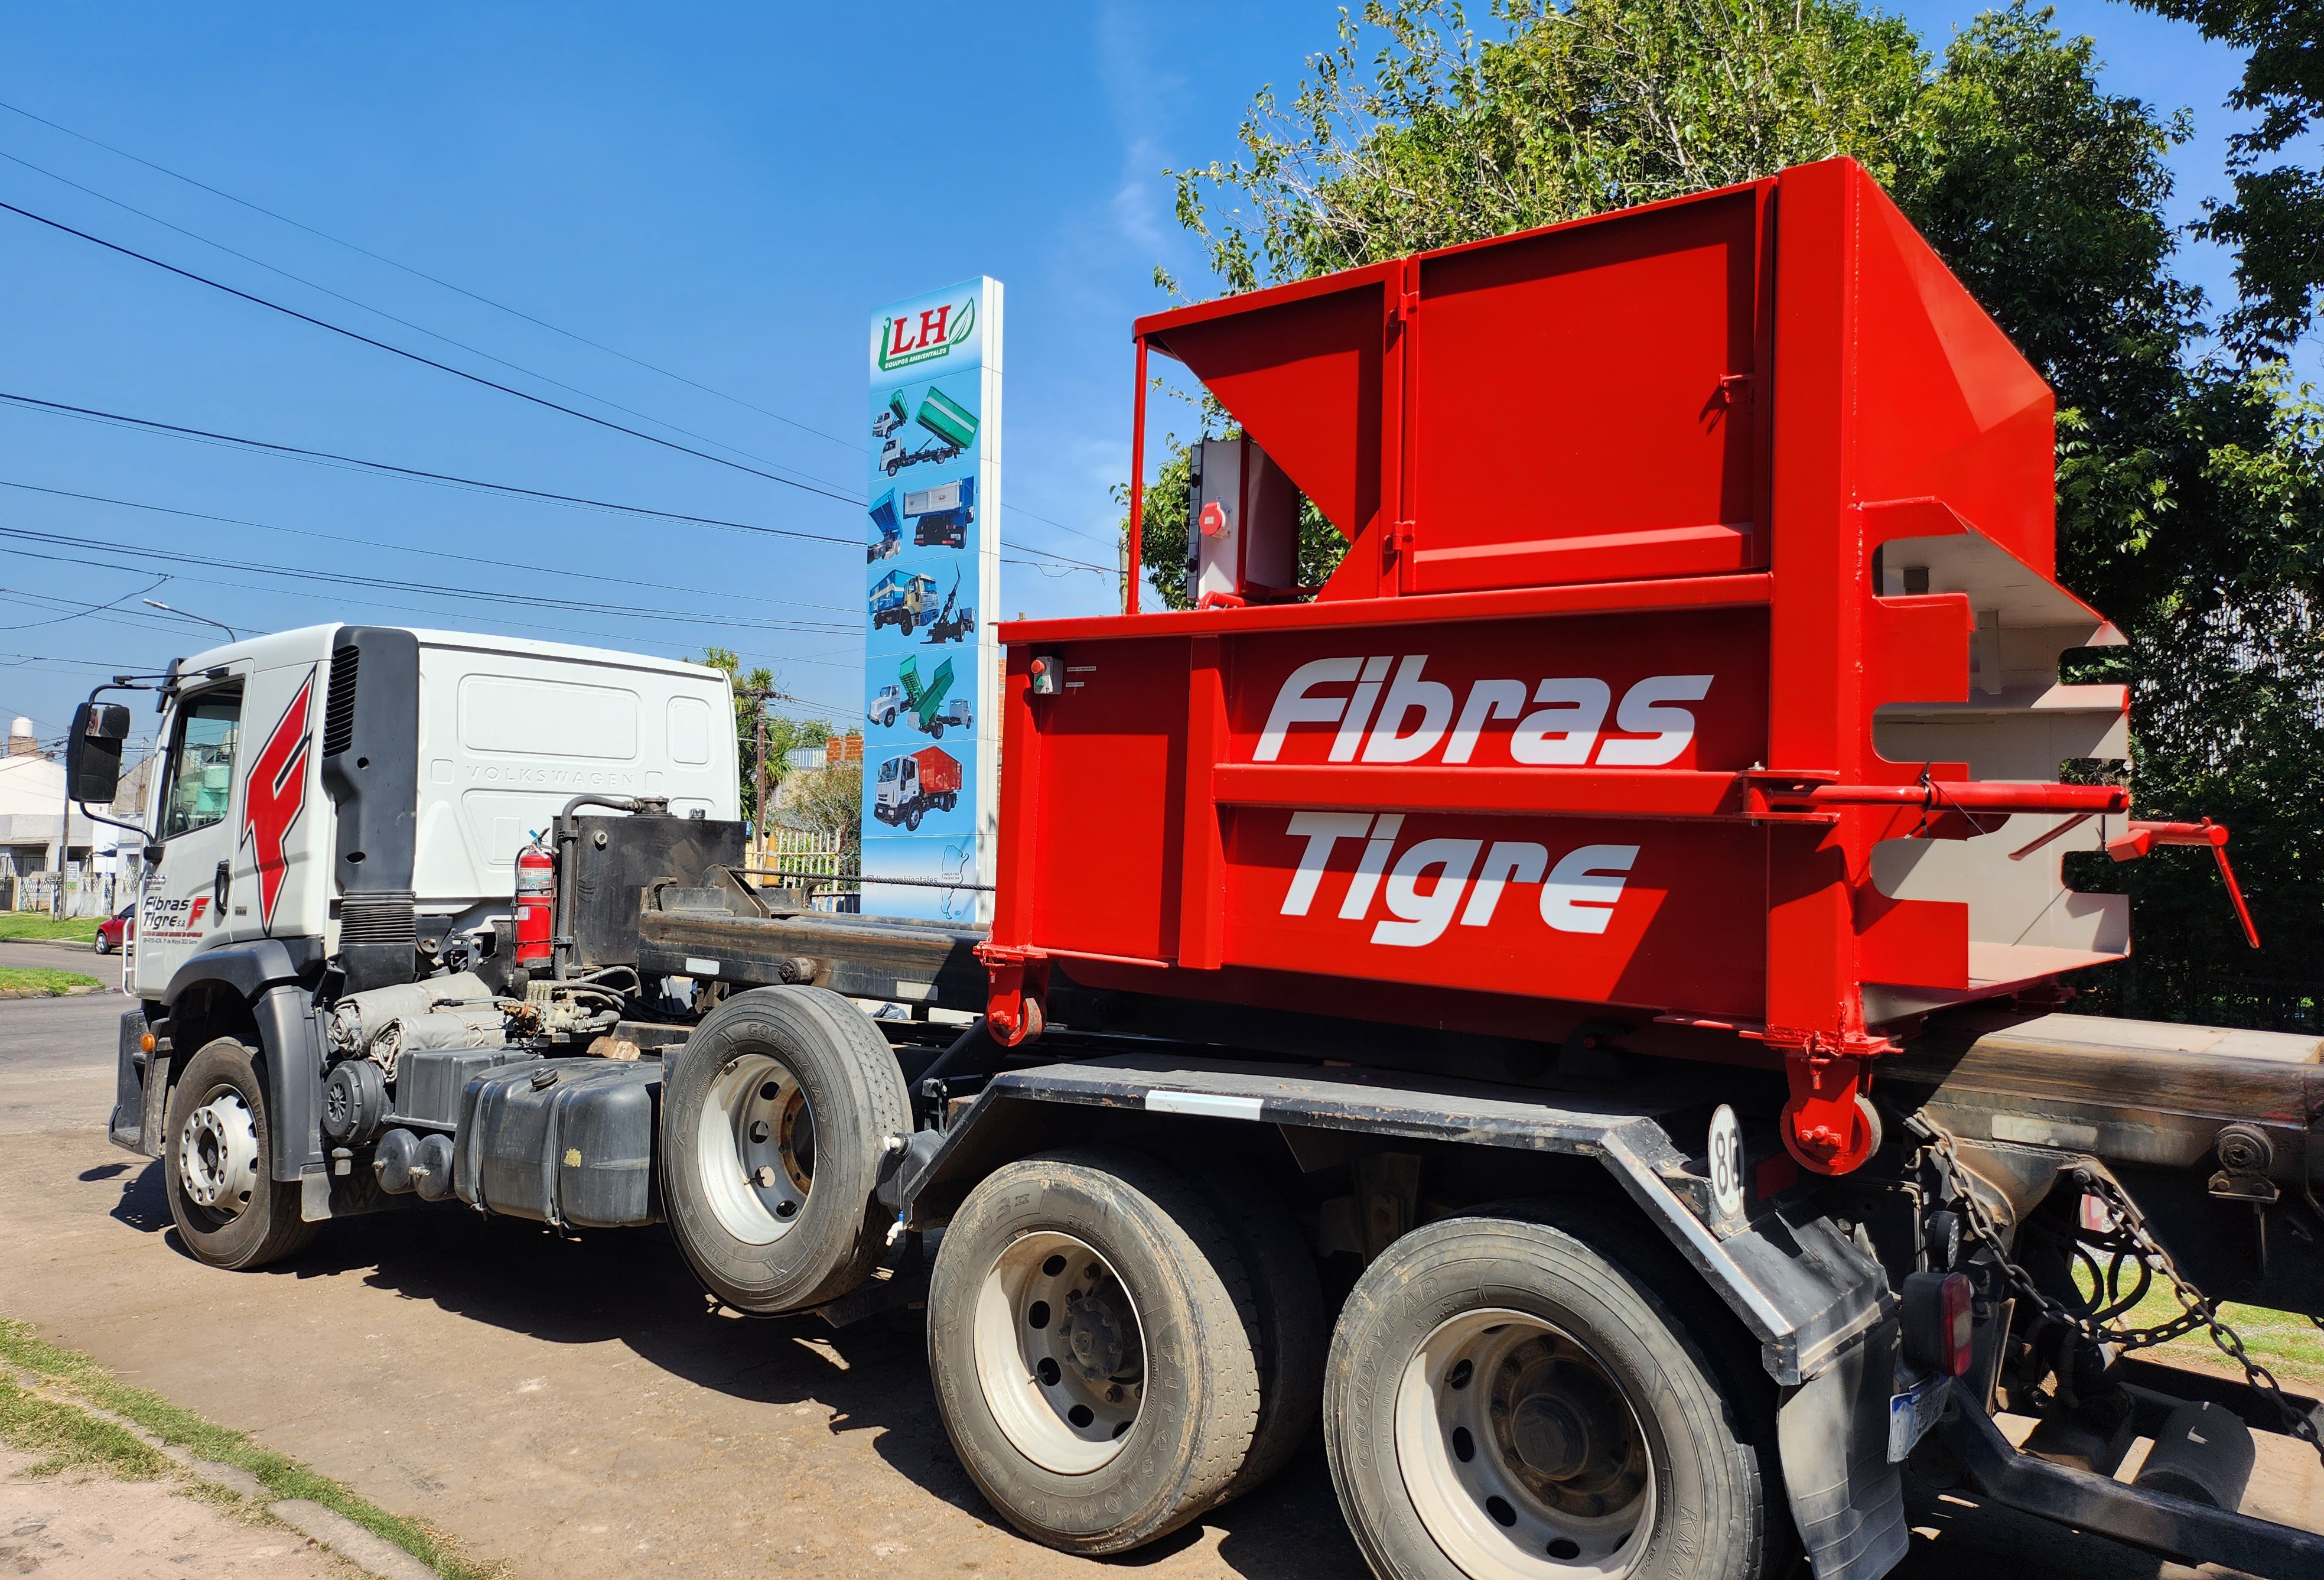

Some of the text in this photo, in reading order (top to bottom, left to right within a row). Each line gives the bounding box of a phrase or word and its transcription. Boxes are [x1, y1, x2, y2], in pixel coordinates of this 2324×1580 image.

[885, 347, 947, 369] EQUIPOS AMBIENTALES
[890, 304, 952, 356] LH
[1252, 654, 1714, 765] Fibras
[466, 766, 634, 787] VOLKSWAGEN
[143, 896, 190, 911] Fibras
[1280, 811, 1641, 947] Tigre
[143, 912, 178, 929] Tigre
[747, 1023, 828, 1123] GOODYEAR
[694, 1227, 731, 1270] KMAX
[1352, 1276, 1442, 1470] GOODYEAR
[1055, 1340, 1183, 1524] Firestone
[1665, 1503, 1699, 1580] KMA
